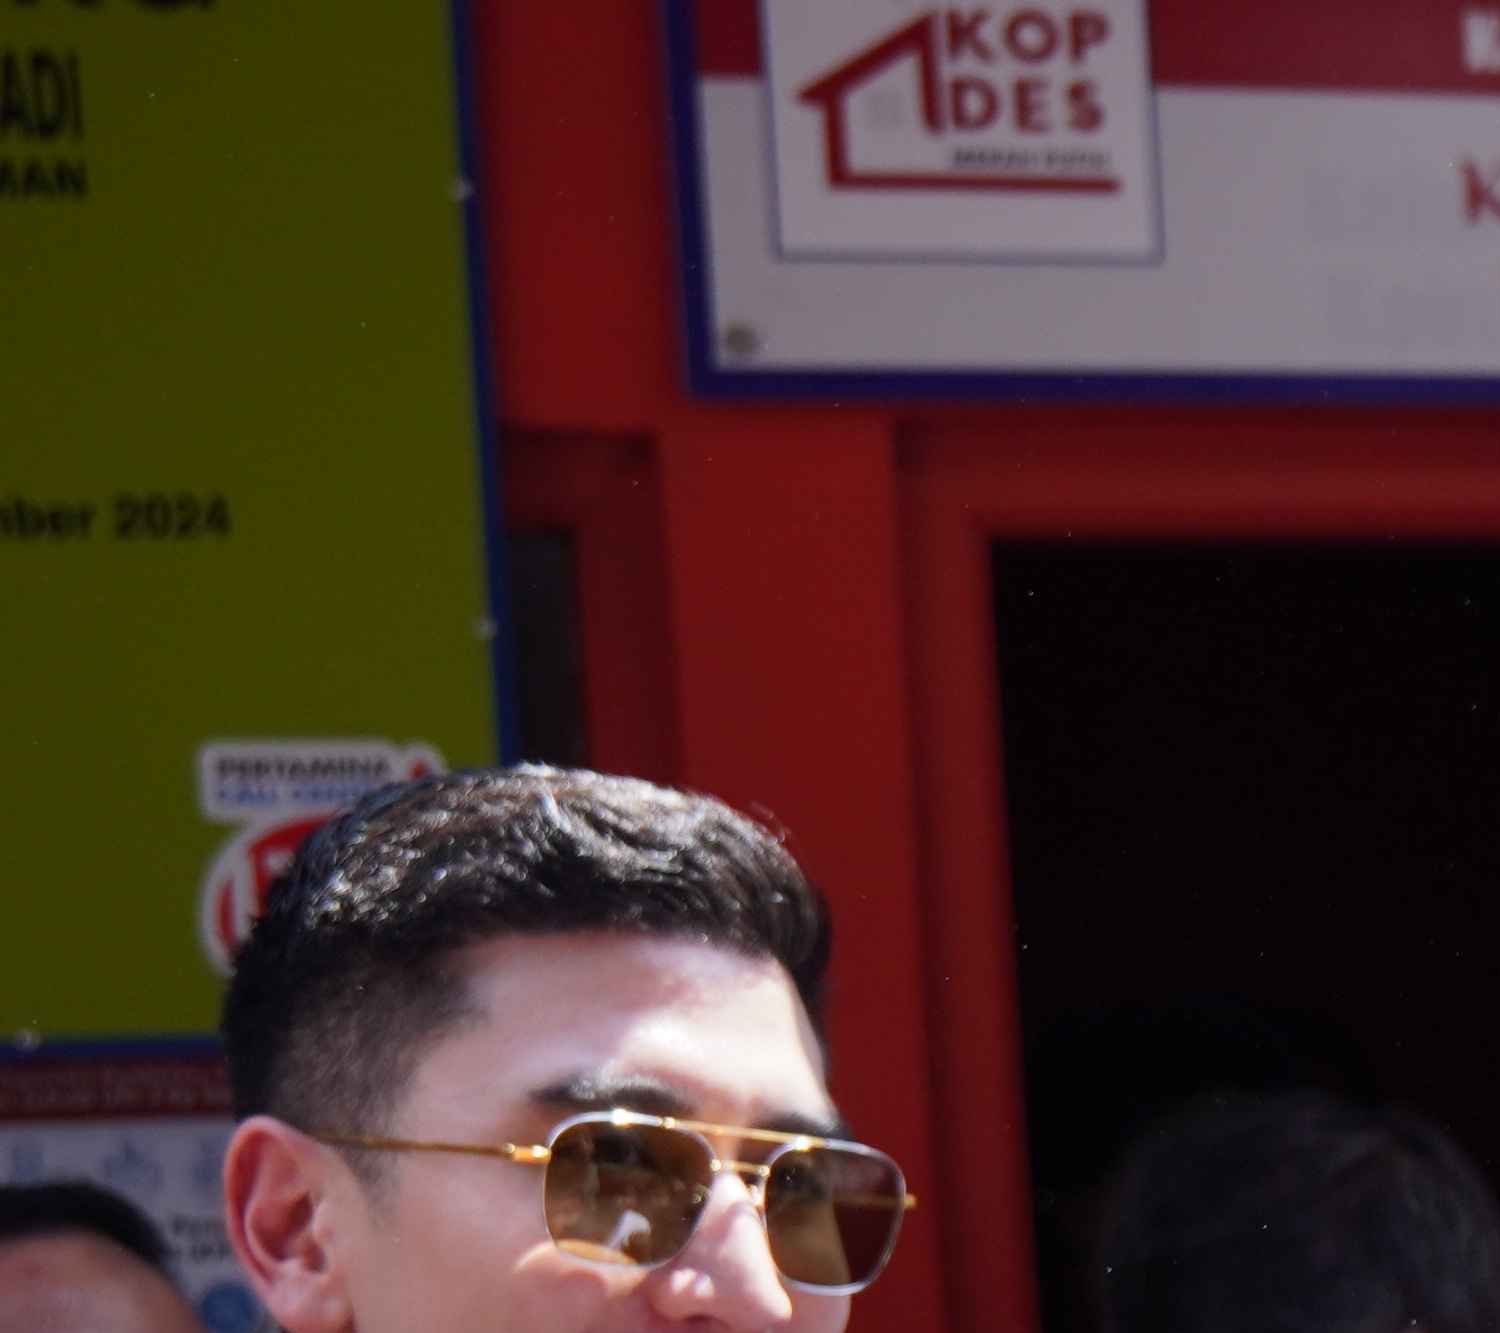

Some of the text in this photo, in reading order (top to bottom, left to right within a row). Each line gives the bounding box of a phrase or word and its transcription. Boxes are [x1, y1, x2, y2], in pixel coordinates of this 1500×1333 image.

[946, 8, 1111, 64] KOP
[949, 77, 1105, 132] DES
[114, 493, 232, 539] 2024
